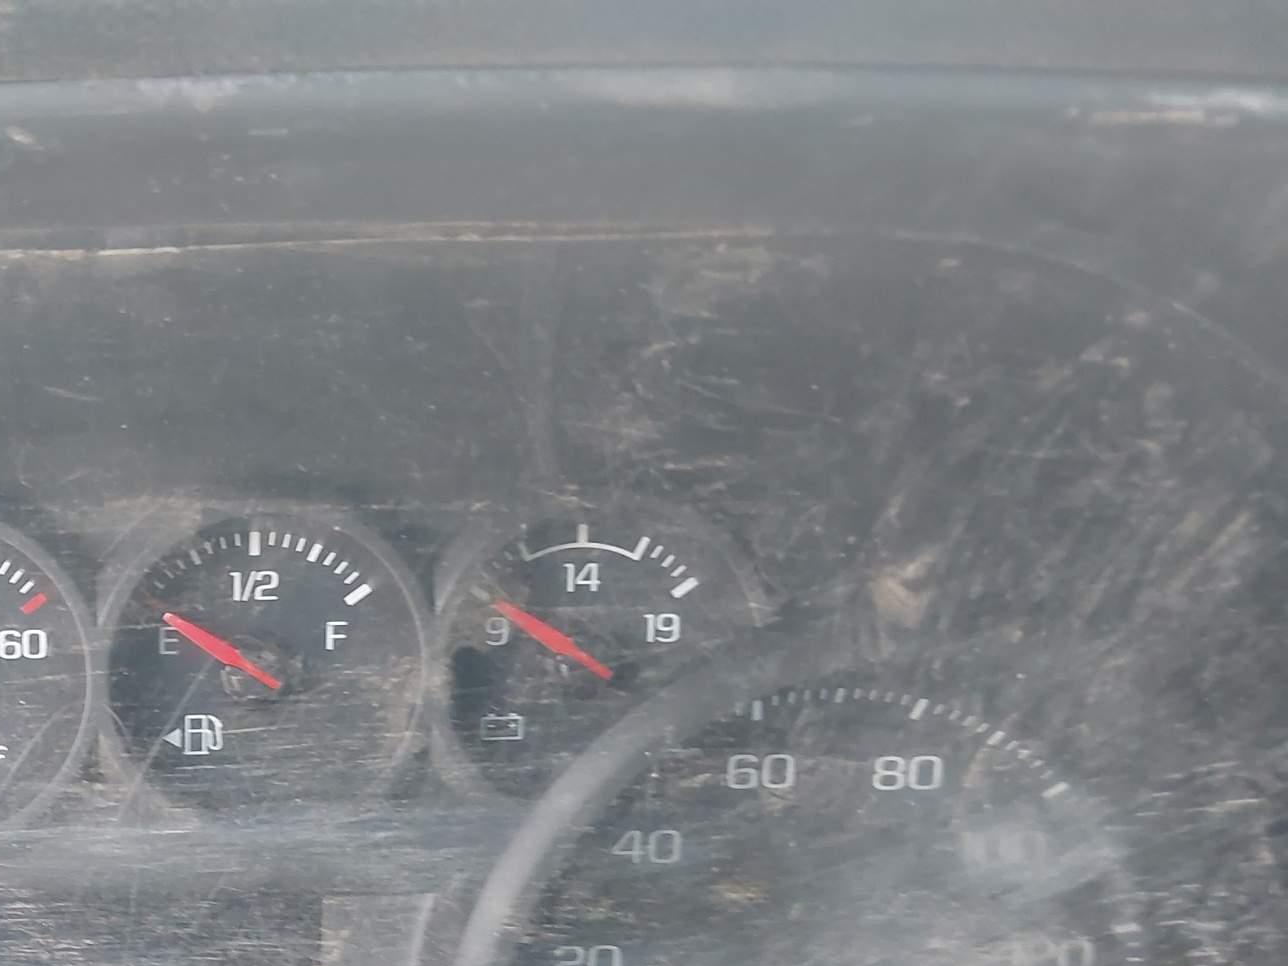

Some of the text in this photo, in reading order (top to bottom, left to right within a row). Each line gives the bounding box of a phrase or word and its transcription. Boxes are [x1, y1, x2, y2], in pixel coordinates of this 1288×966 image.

[229, 571, 280, 602] 1/2
[564, 563, 601, 593] 14
[158, 626, 180, 656] E
[326, 621, 349, 650] F
[486, 617, 510, 647] 9
[645, 613, 681, 643] 19
[726, 754, 796, 790] 60
[872, 755, 944, 791] 80
[613, 829, 682, 865] 40
